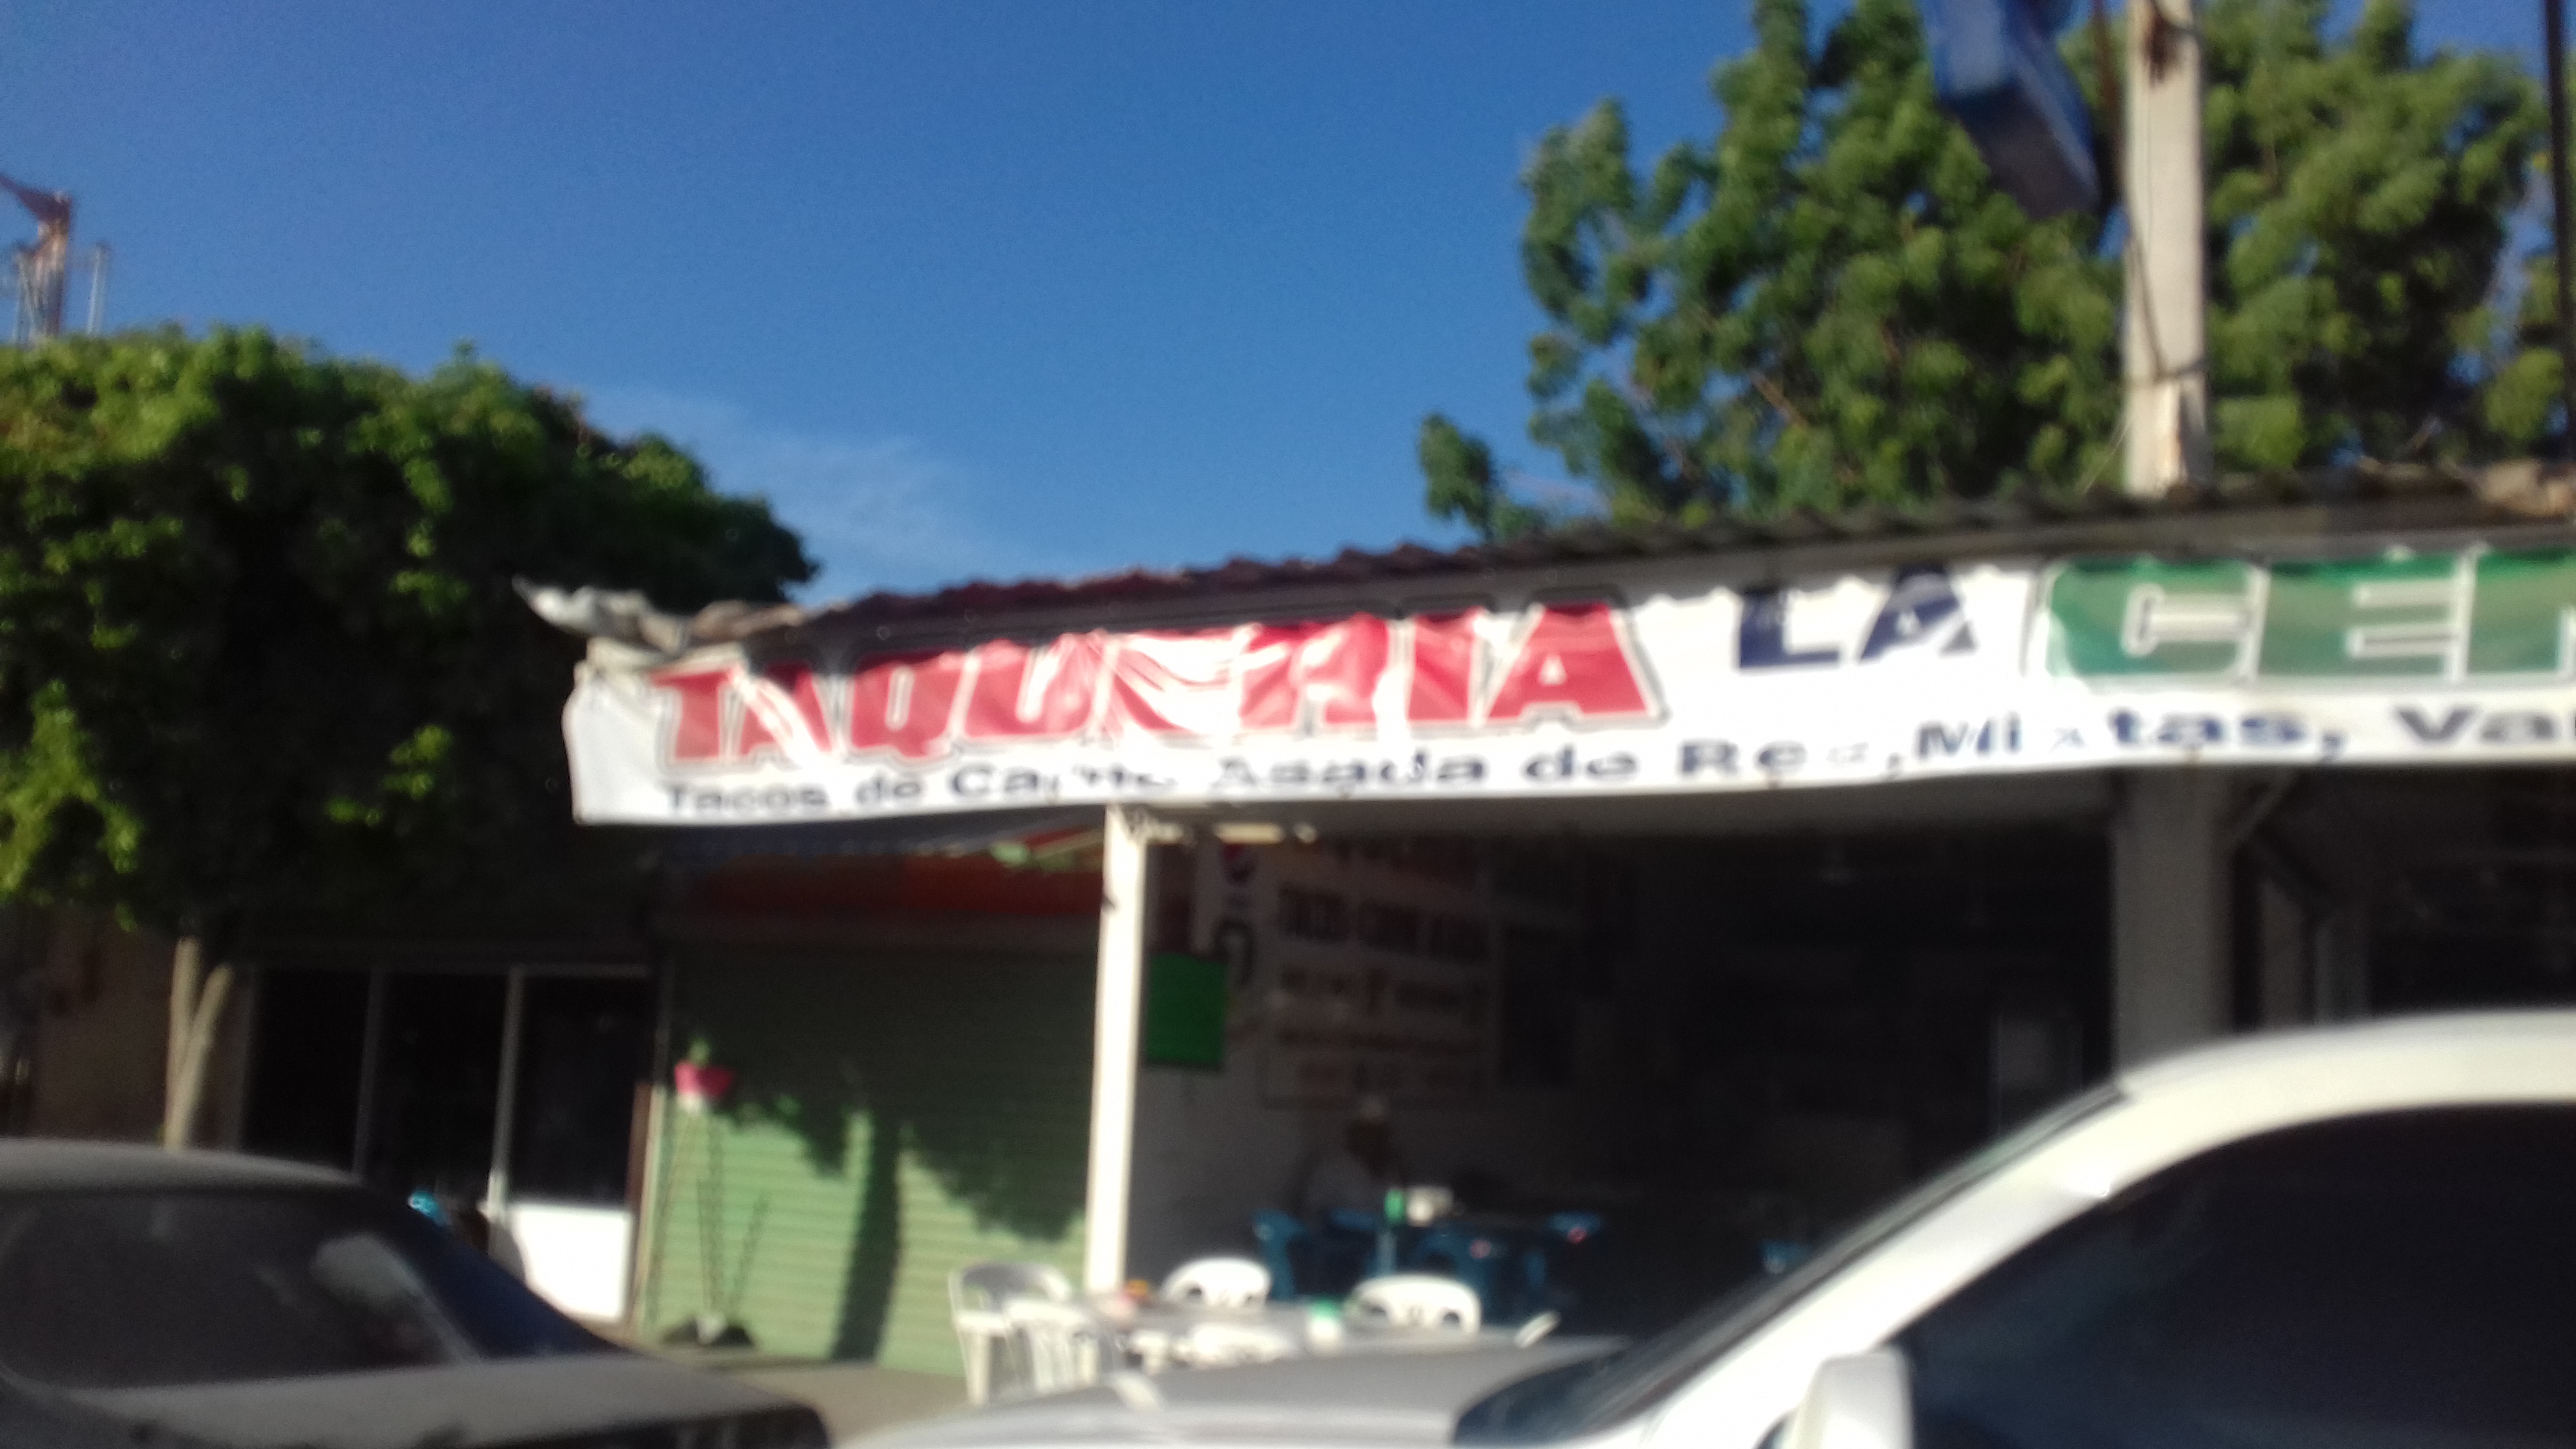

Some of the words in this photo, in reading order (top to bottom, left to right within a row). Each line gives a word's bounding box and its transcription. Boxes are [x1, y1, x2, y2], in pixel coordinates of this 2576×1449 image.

[1736, 562, 1979, 669] LA
[667, 783, 829, 814] Tacos
[855, 770, 924, 805] de
[1521, 743, 1639, 781] de
[2393, 705, 2576, 747] Va
